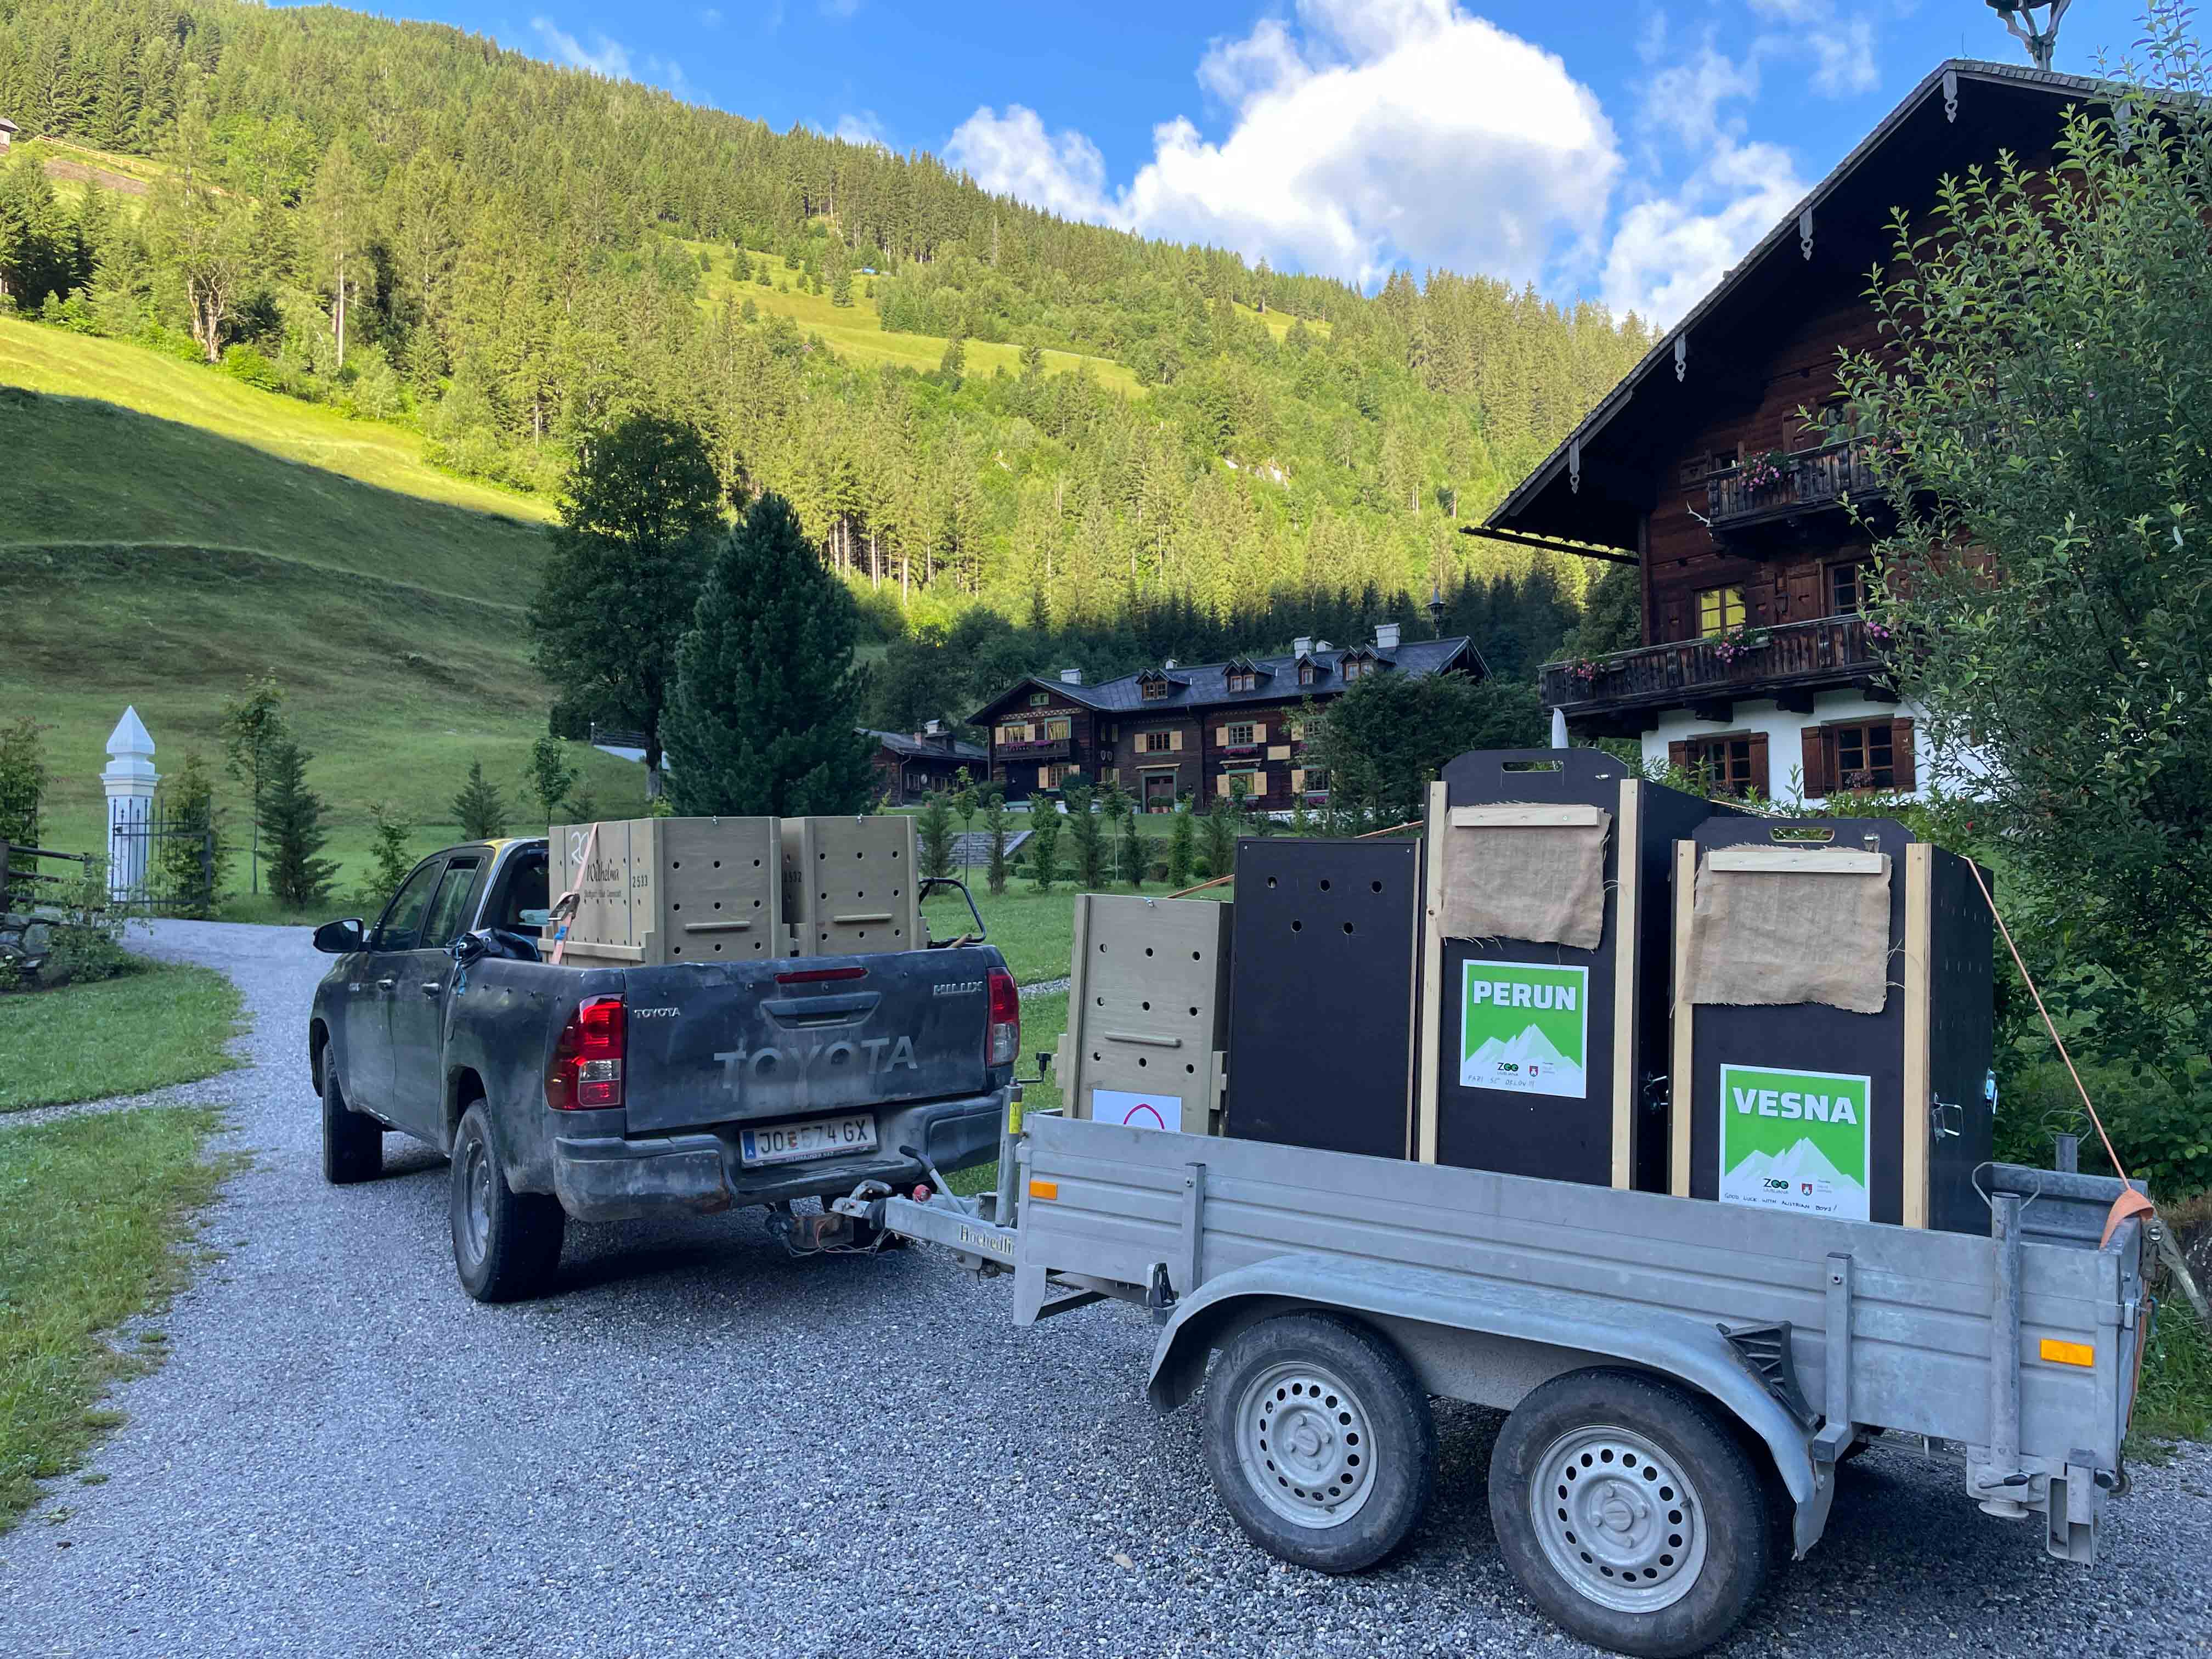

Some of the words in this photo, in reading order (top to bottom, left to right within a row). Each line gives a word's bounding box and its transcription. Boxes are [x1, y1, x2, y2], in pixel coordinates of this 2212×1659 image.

[586, 861, 619, 882] Wilhelma
[632, 874, 648, 888] 2533
[1474, 980, 1576, 1011] PERUN
[634, 1007, 680, 1018] TOYOTA
[714, 1035, 918, 1089] TOYOTA
[1497, 1062, 1519, 1071] ZOO
[1732, 1087, 1857, 1125] VESNA
[843, 1119, 867, 1142] GX
[1763, 1178, 1788, 1189] ZOO
